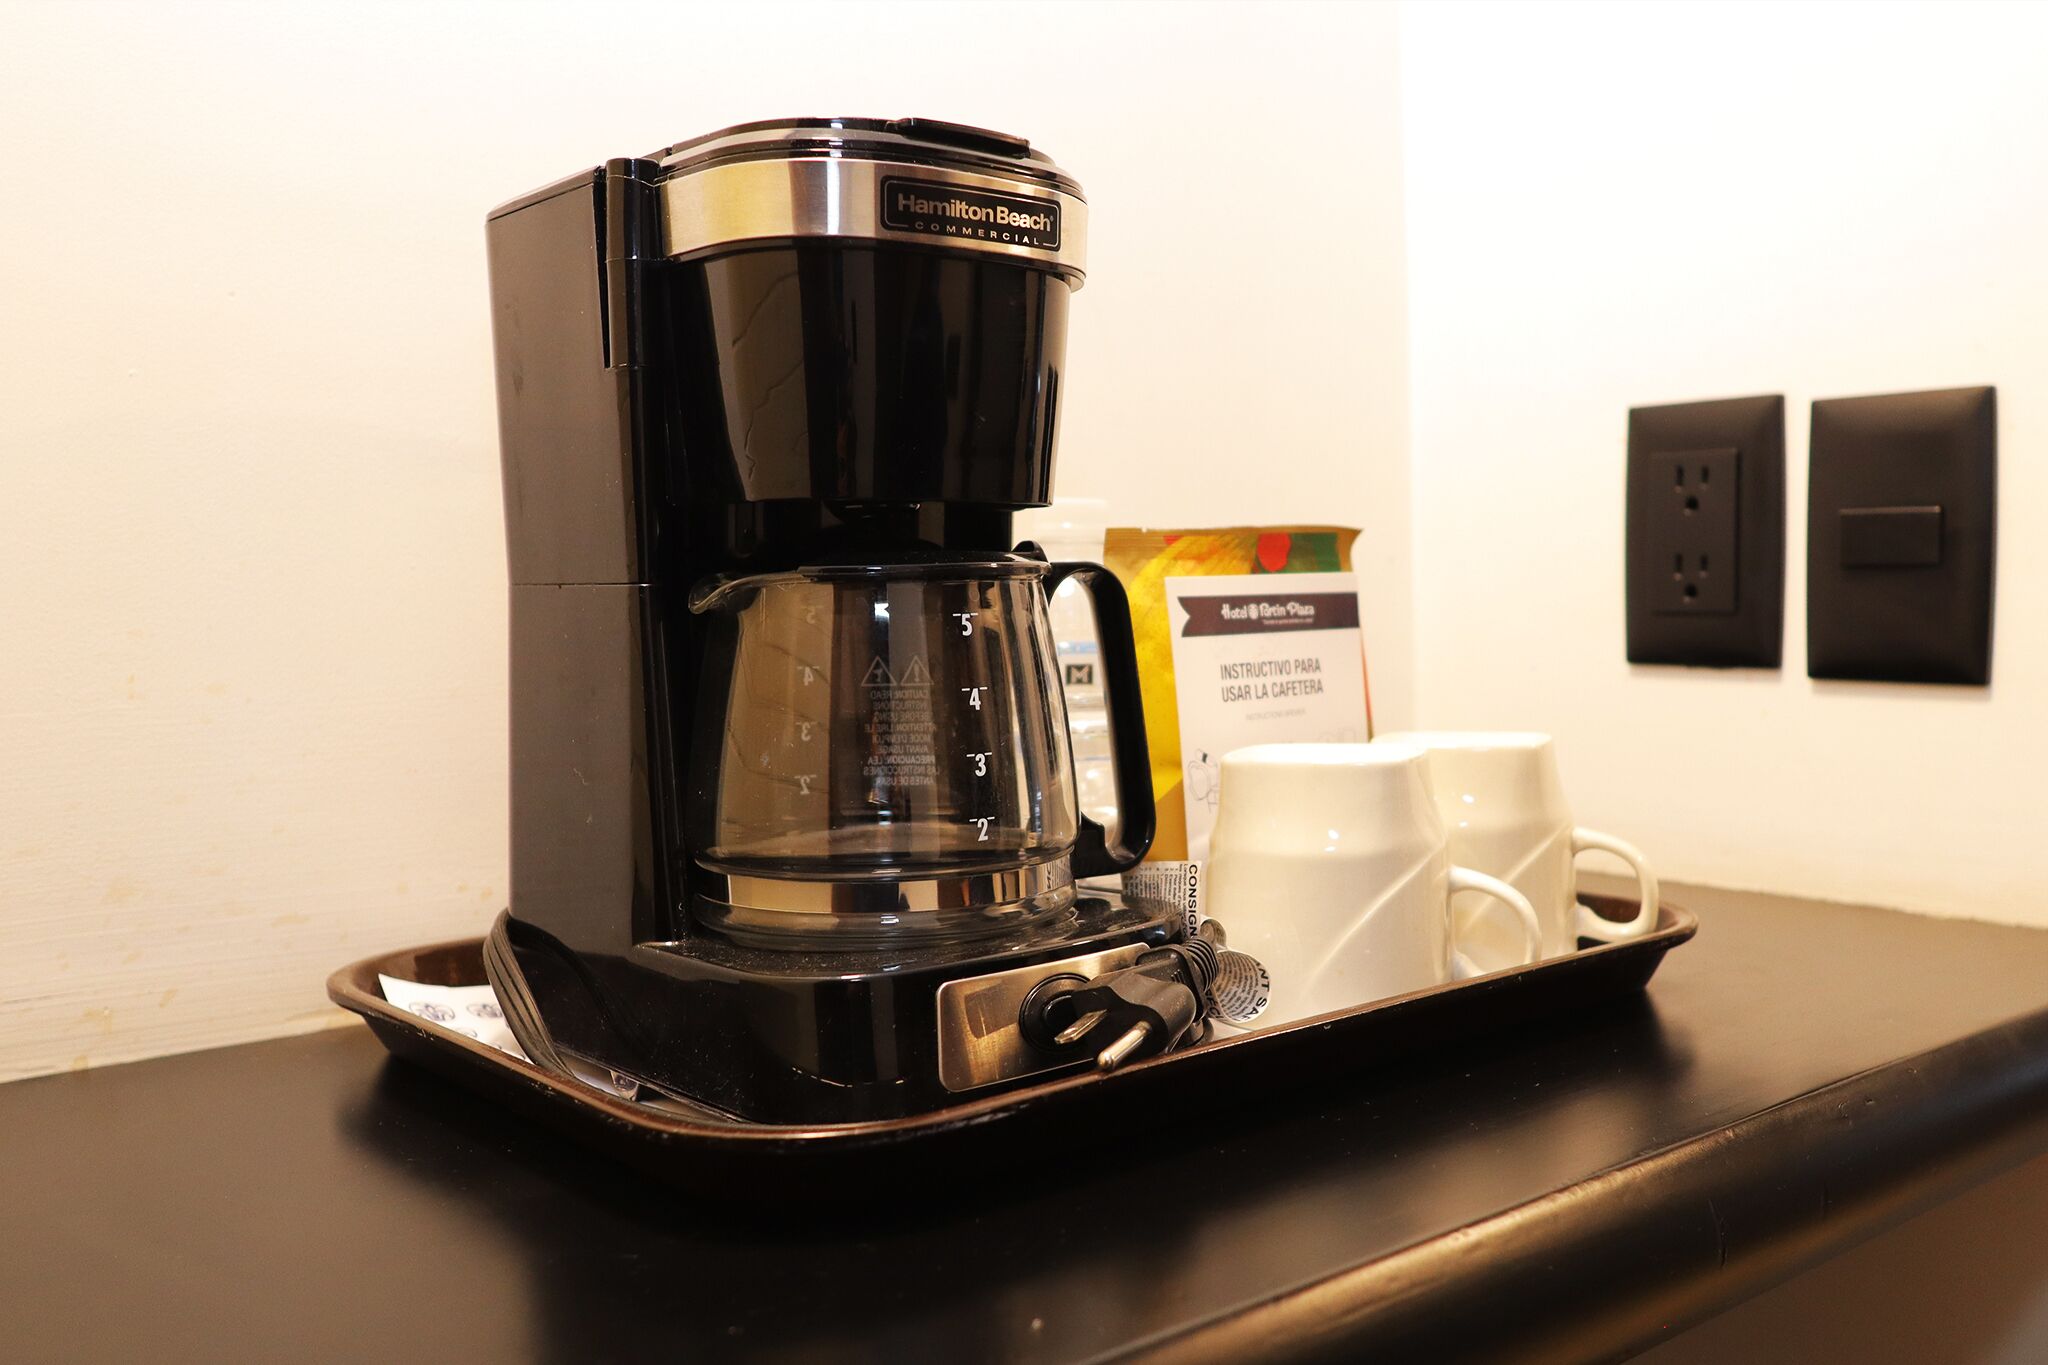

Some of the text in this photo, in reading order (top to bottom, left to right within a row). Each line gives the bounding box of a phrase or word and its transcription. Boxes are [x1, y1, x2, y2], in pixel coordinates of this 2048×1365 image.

[898, 193, 995, 222] Hamilton
[915, 221, 1040, 245] COMMERCIAL
[1221, 603, 1248, 620] Hotel
[1286, 601, 1315, 616] Plaza
[961, 613, 972, 636] 5
[1220, 658, 1321, 681] INSTRUCTIVO PARA
[969, 688, 981, 711] 4
[1221, 678, 1324, 703] USAR LA CAFETERA
[975, 754, 987, 777] 3
[977, 818, 989, 842] 2
[1188, 864, 1198, 937] CONSIGN
